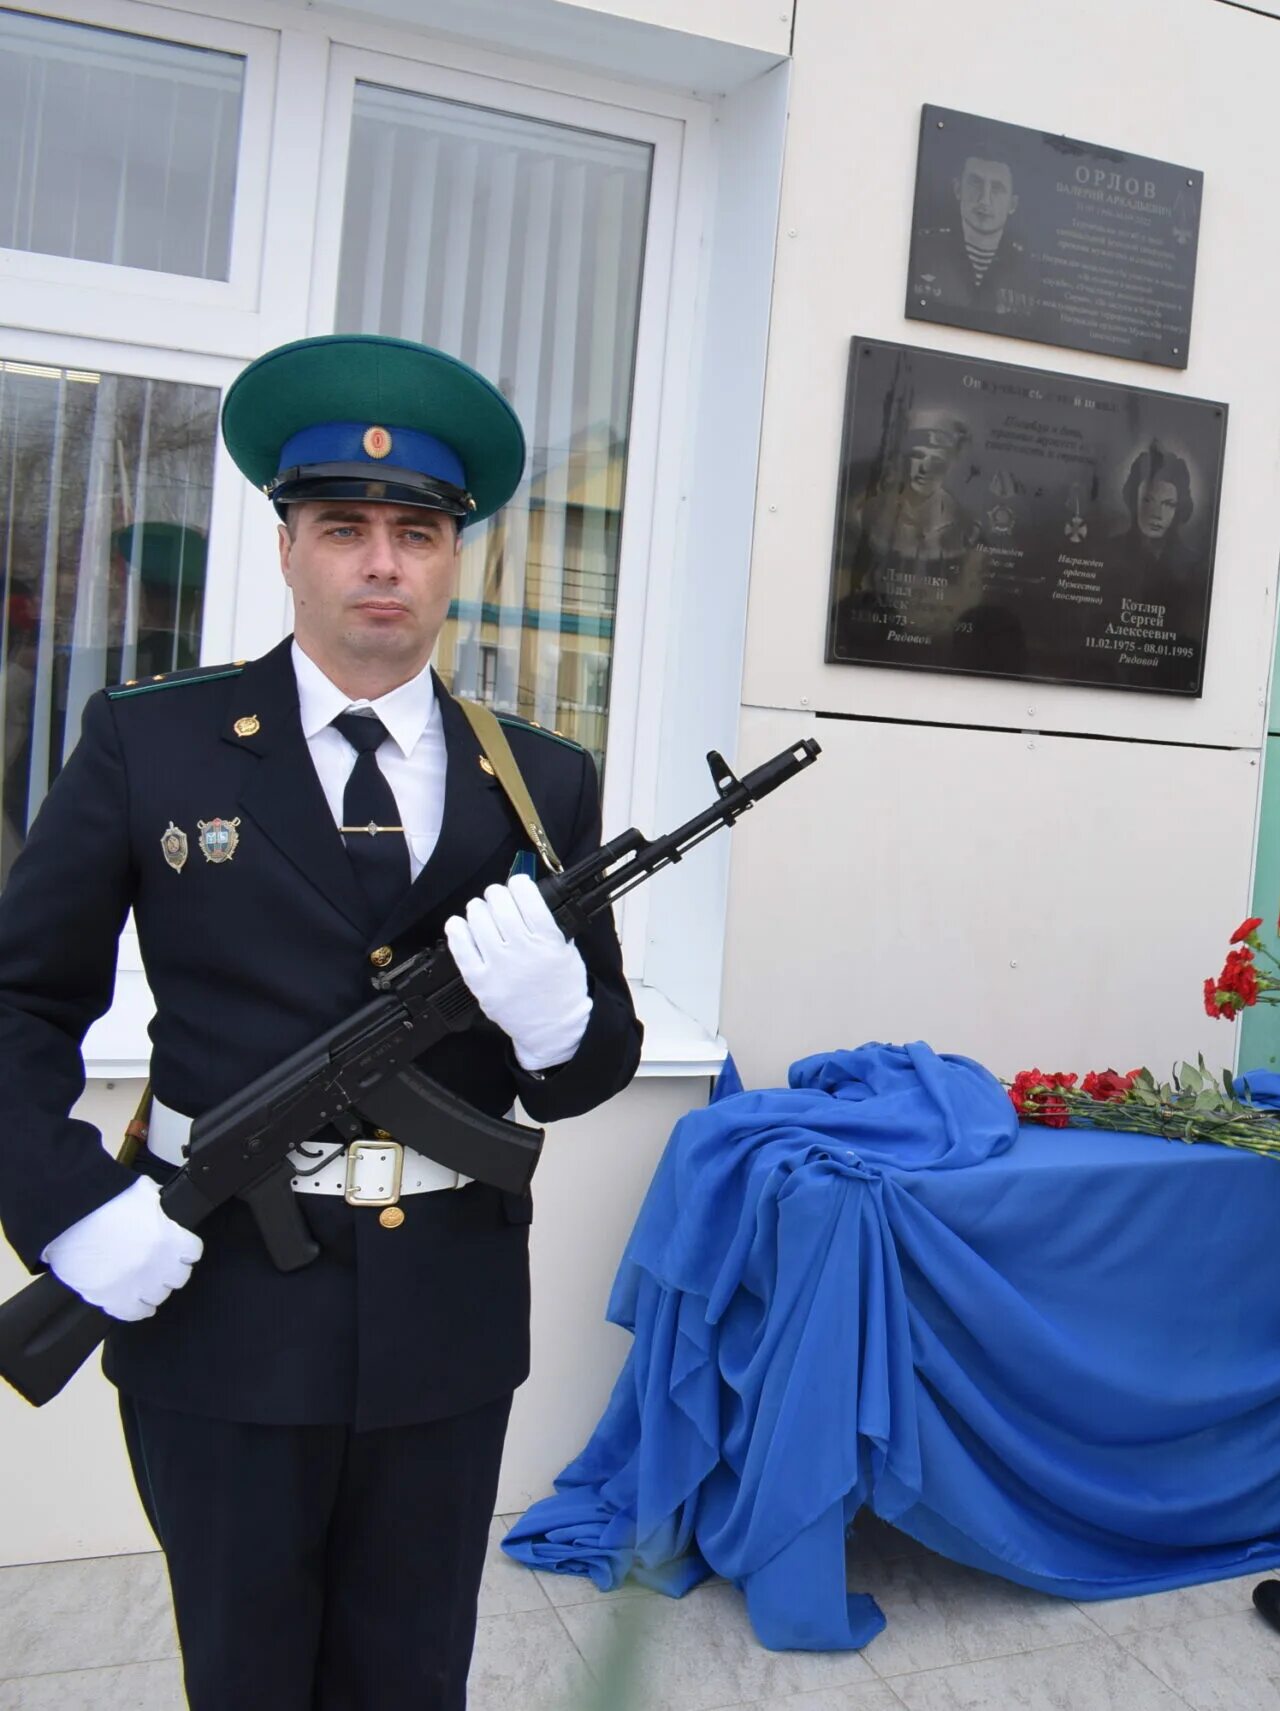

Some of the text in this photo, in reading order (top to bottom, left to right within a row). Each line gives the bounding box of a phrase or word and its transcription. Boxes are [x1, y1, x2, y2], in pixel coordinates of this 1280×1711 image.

[1075, 165, 1157, 199] ОРЛОВ
[1058, 554, 1104, 568] Награжден
[1063, 568, 1096, 579] орденом
[1058, 578, 1101, 592] Мужества
[1052, 591, 1103, 605] (посмертно)
[1121, 598, 1166, 617] Котляр
[1120, 611, 1164, 628] Сергей
[1105, 622, 1177, 641] Алексеевич
[1085, 637, 1136, 652] 11.02.1975
[1143, 643, 1195, 658] 08.01.1995
[1118, 653, 1160, 667] Рядовой
